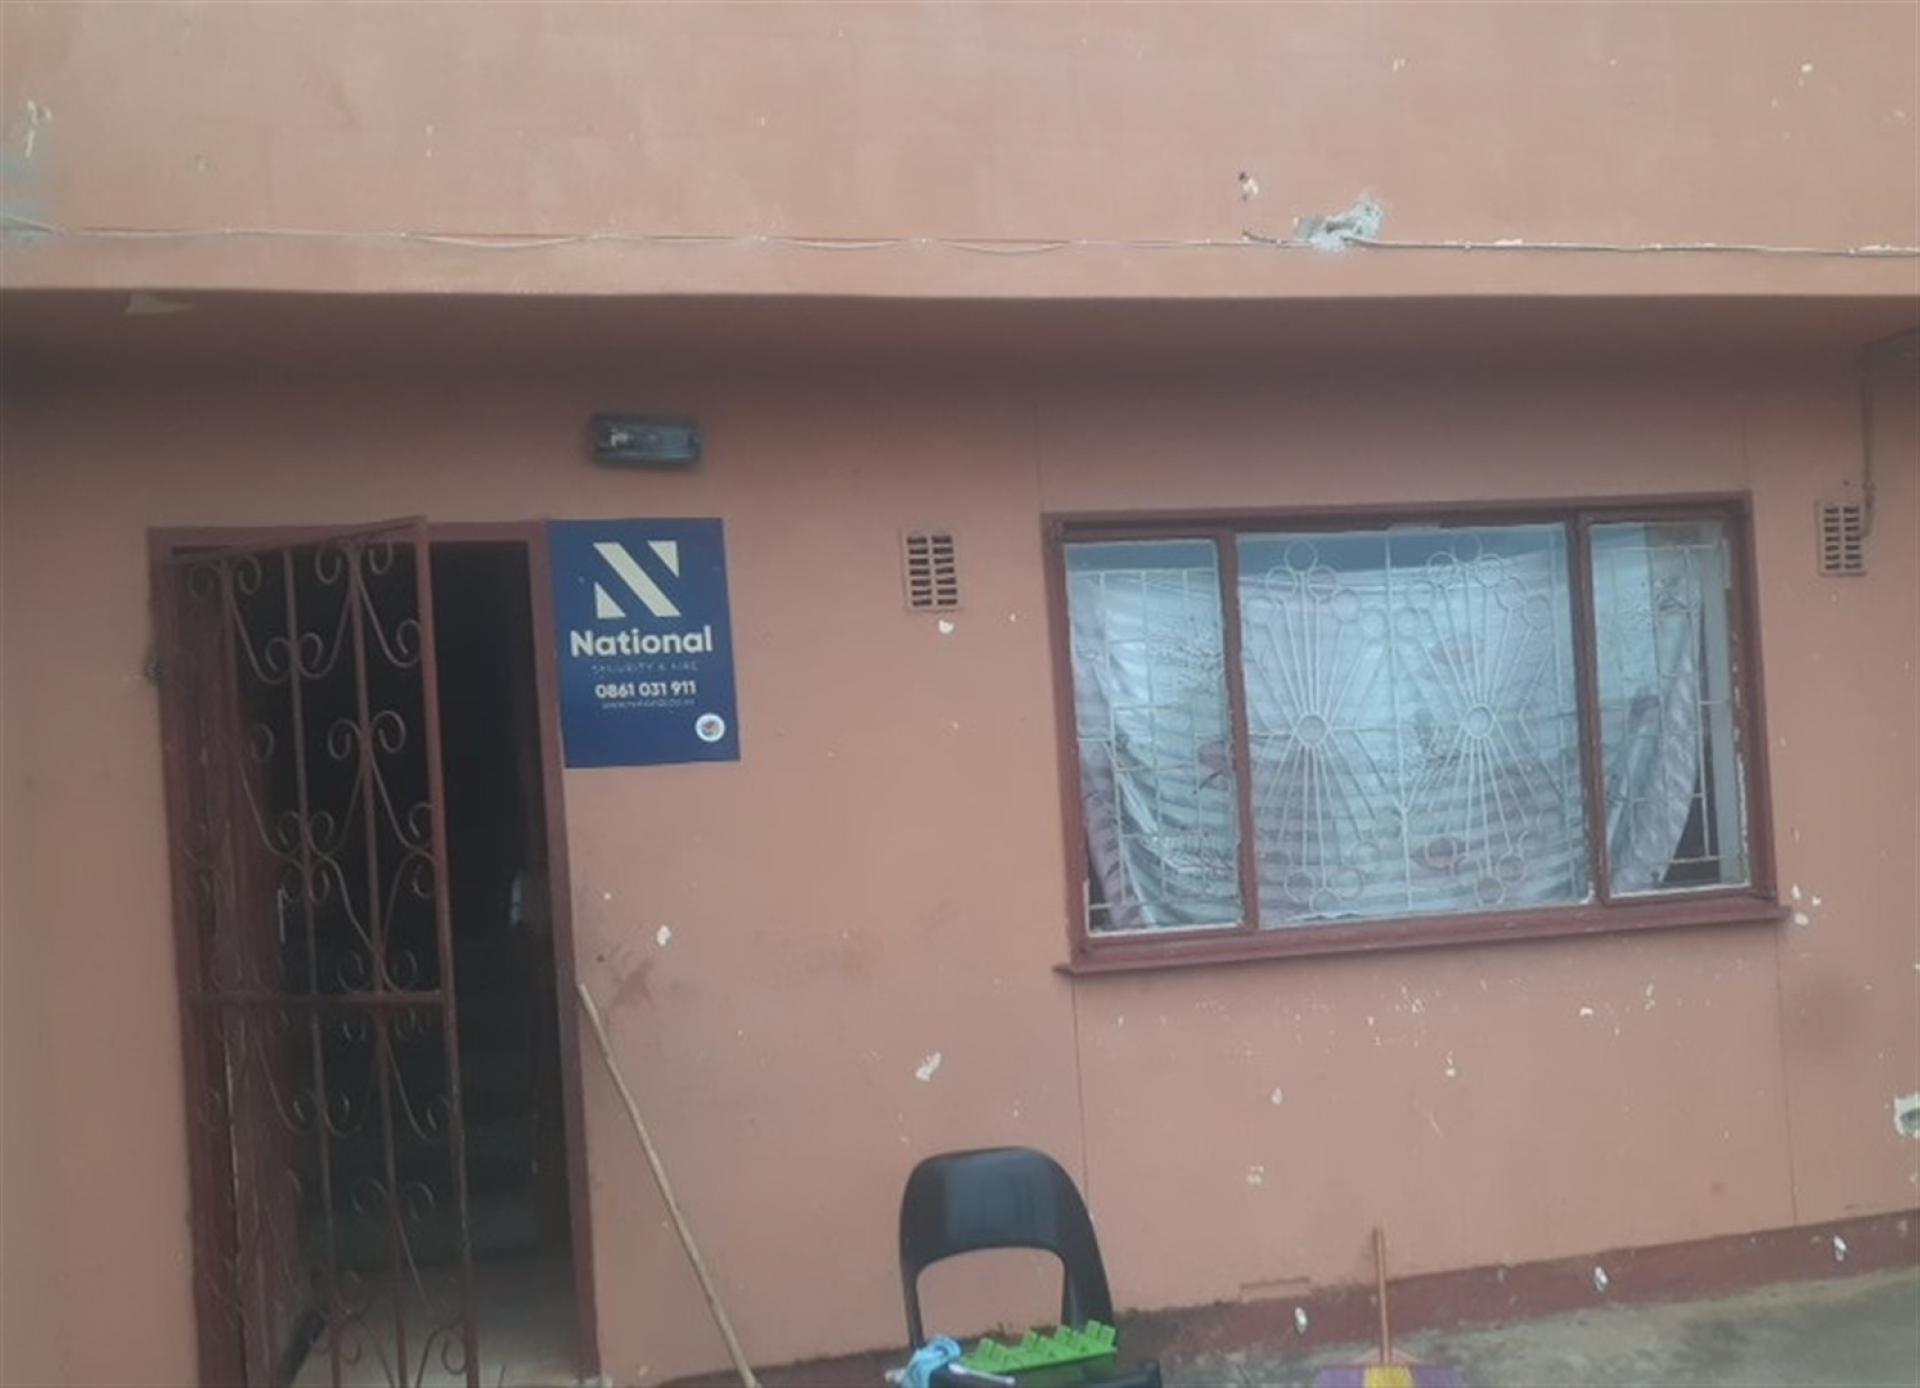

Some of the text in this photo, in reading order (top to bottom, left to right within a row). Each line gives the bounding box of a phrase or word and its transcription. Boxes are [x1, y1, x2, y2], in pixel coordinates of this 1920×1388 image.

[570, 625, 713, 657] National
[595, 680, 696, 699] 0861 031 911
